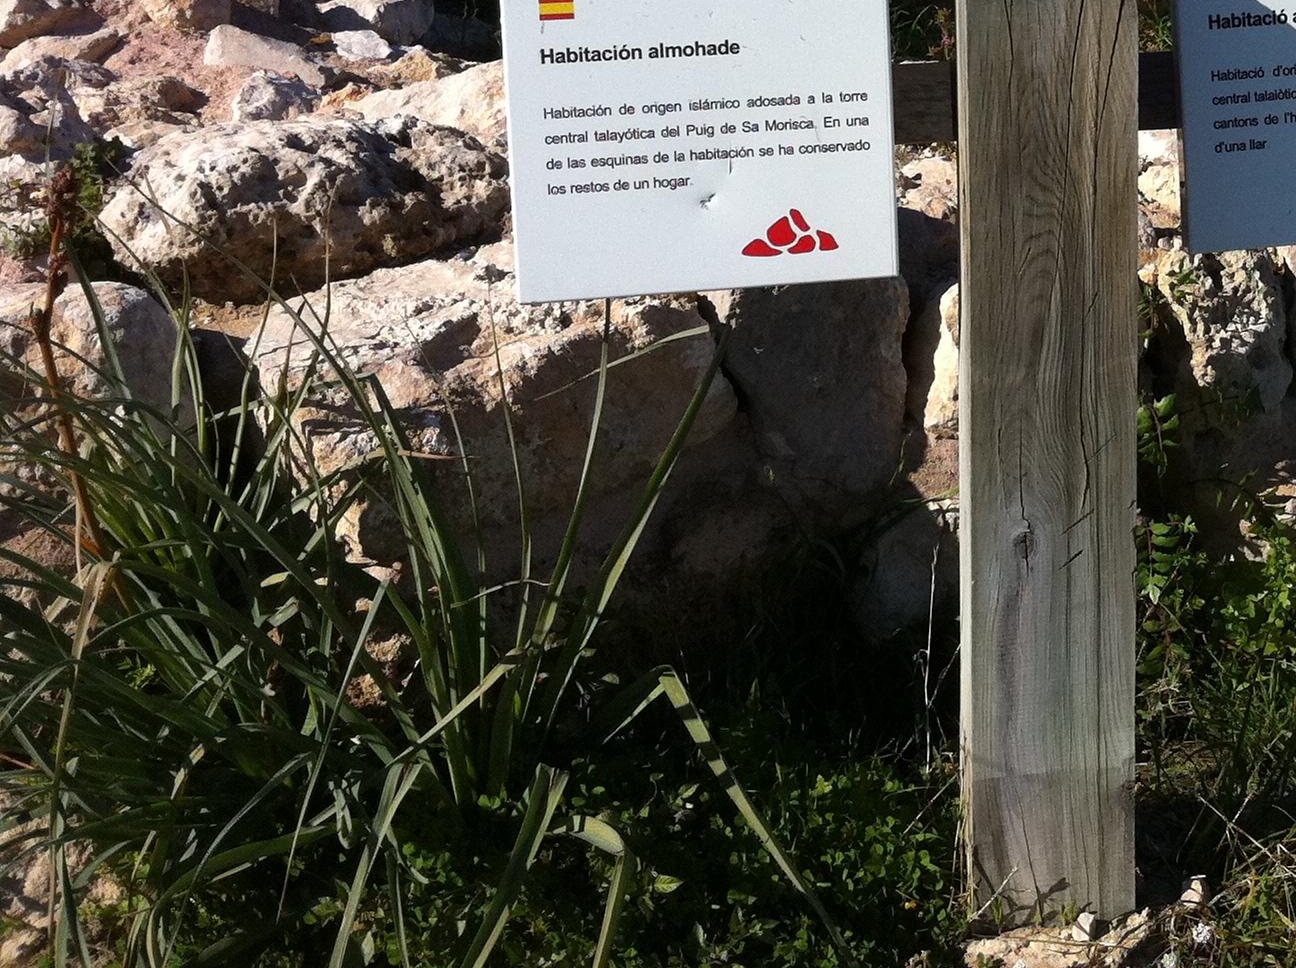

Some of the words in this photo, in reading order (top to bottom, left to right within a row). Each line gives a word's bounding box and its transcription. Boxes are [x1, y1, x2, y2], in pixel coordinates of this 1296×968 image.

[1208, 10, 1288, 30] Habitació
[540, 45, 642, 64] Habitación
[648, 40, 741, 57] almohade
[1211, 68, 1264, 82] Habitació
[543, 104, 612, 120] Habitación
[619, 102, 635, 116] de
[642, 101, 682, 116] origen
[688, 97, 741, 112] islámico
[747, 94, 801, 109] adosada
[807, 95, 815, 105] a
[822, 92, 833, 103] la
[840, 90, 868, 103] torre
[1212, 92, 1251, 106] central
[545, 130, 589, 145] central
[594, 127, 655, 144] talayótica
[661, 125, 680, 138] del
[686, 123, 715, 139] Puig
[720, 122, 736, 135] de
[742, 120, 759, 134] Sa
[824, 116, 841, 128] En
[846, 115, 870, 127] una
[1213, 116, 1259, 130] cantons
[1264, 113, 1279, 125] de
[546, 157, 563, 170] de
[567, 156, 586, 169] las
[590, 154, 648, 172] esquinas
[653, 151, 670, 164] de
[674, 150, 686, 163] la
[690, 145, 754, 162] habitación
[758, 146, 774, 157] se
[778, 143, 794, 156] ha
[798, 139, 871, 155] conservado
[1214, 140, 1246, 154] d'una
[1249, 138, 1267, 150] llar
[547, 183, 567, 196] los
[570, 180, 610, 194] restos
[613, 178, 631, 191] de
[633, 178, 650, 190] un
